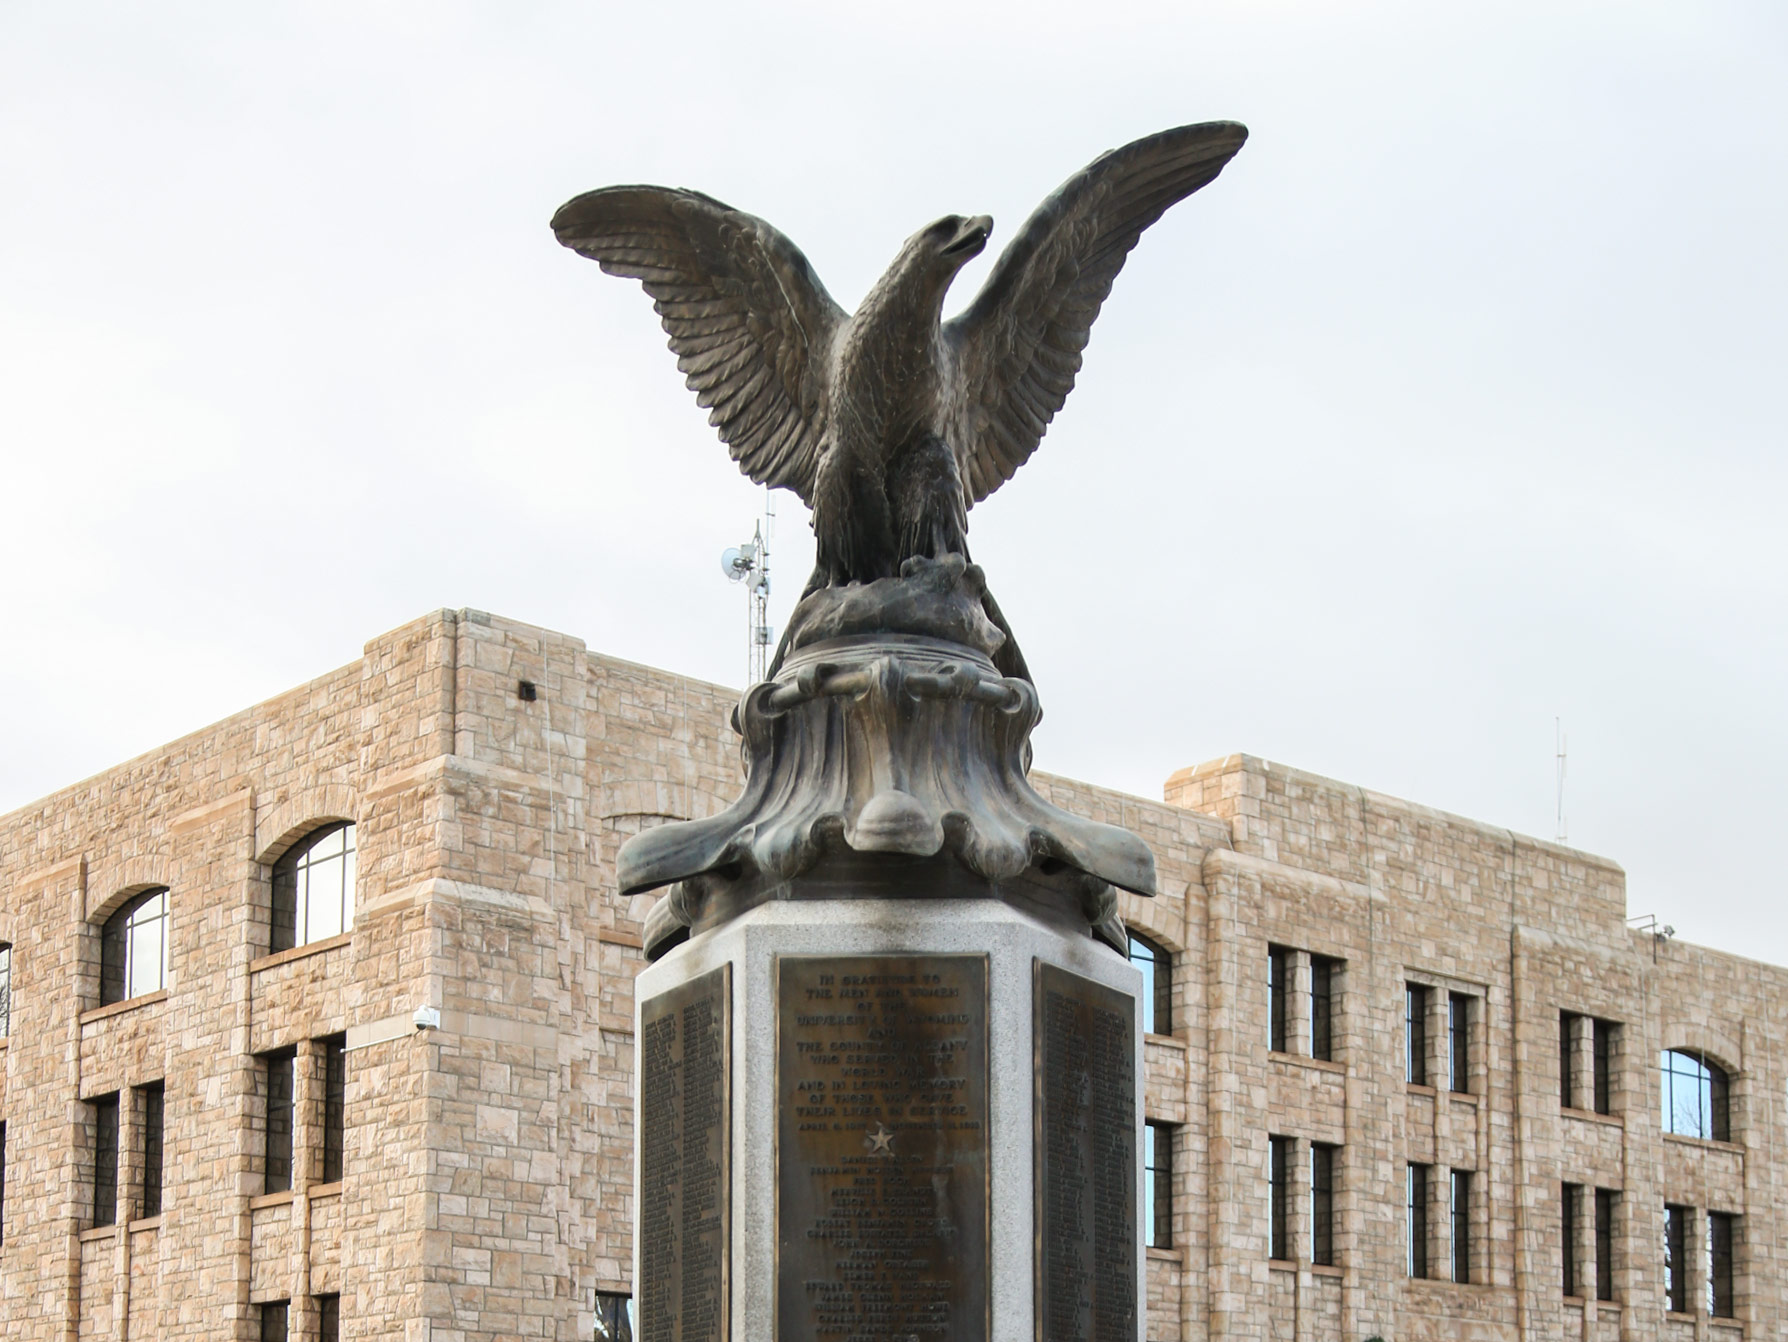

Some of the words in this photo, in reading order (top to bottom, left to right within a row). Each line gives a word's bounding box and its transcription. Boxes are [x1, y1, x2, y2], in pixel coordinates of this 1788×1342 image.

[819, 975, 834, 985] IN
[922, 975, 941, 985] TO
[806, 988, 833, 999] THE
[839, 988, 870, 999] MEN
[857, 1002, 872, 1011] OF
[797, 1015, 877, 1026] UNIVERSITY
[796, 1041, 824, 1052] THE
[810, 1054, 840, 1065] WHO
[797, 1080, 825, 1091] AND
[832, 1080, 846, 1091] IN
[810, 1094, 826, 1105] OF
[832, 1094, 874, 1105] THOSE
[796, 1107, 836, 1117] THEIR
[843, 1107, 881, 1117] LIVES
